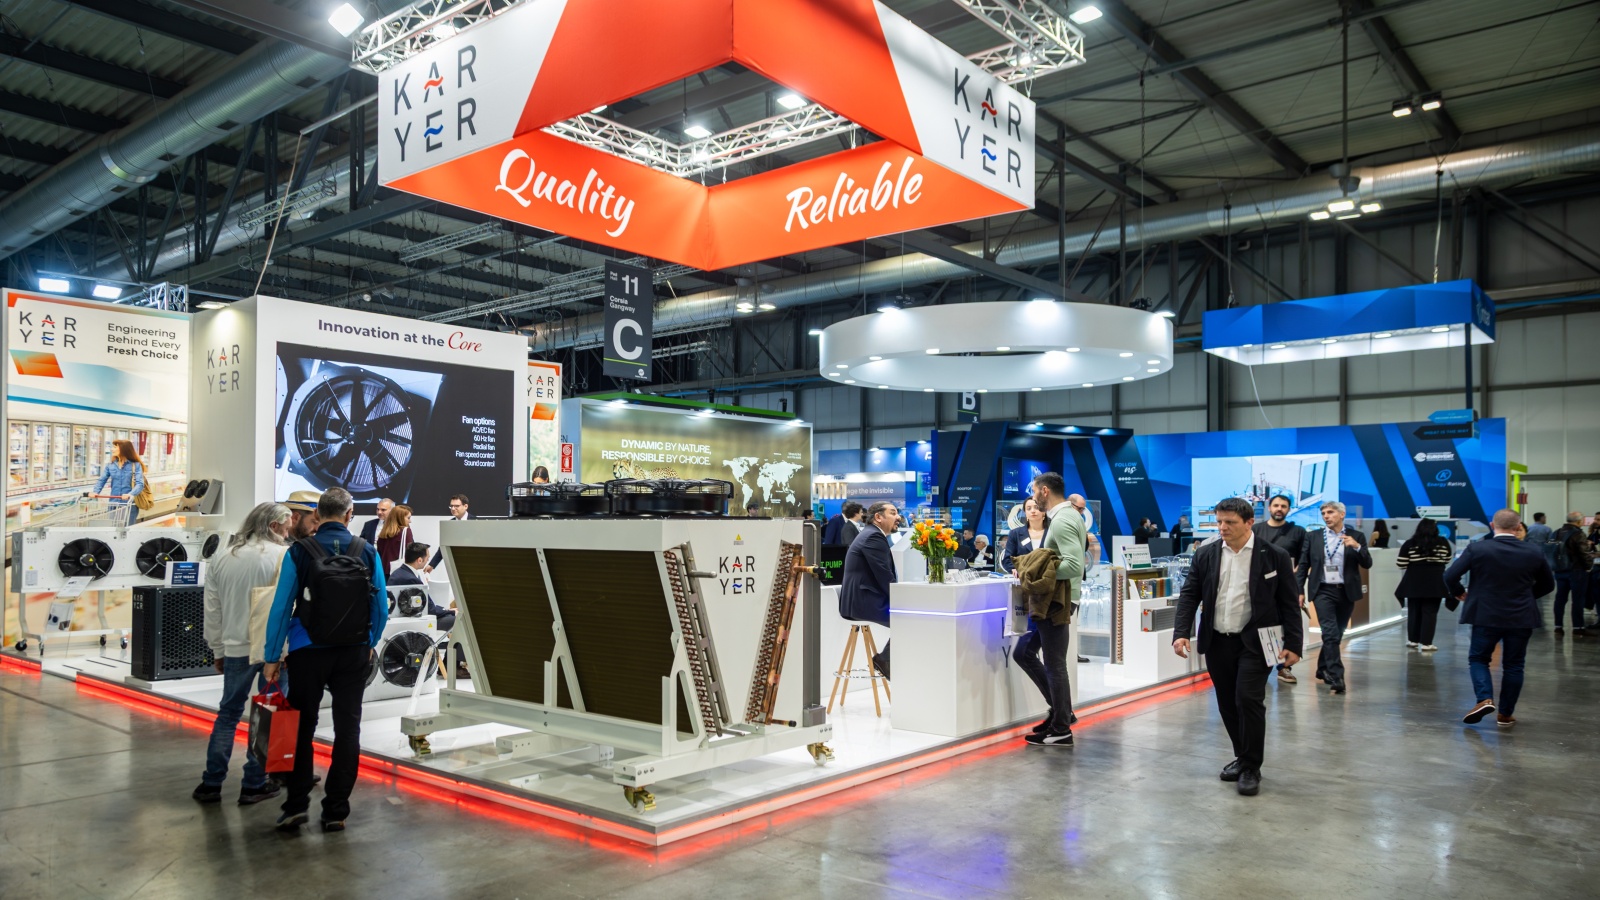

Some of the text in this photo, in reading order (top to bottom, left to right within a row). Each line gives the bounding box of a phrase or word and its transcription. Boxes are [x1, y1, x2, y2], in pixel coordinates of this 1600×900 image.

[394, 44, 477, 116] KAR
[954, 67, 1022, 142] KAR
[394, 97, 477, 162] YER
[954, 118, 1022, 188] YER
[495, 148, 635, 238] Quality
[784, 156, 924, 232] Reliable
[622, 275, 638, 296] 11
[610, 295, 628, 305] Corsia
[610, 302, 635, 313] Gangway
[19, 311, 77, 332] KAR
[108, 323, 176, 339] Engineering
[19, 328, 77, 349] YER
[108, 334, 181, 351] Behind Every
[318, 319, 483, 353] Innovation at the Core
[612, 318, 643, 360] C
[107, 346, 179, 360] Fresh Choice
[207, 344, 240, 369] KAR
[207, 370, 240, 394] YER
[462, 415, 496, 426] Fan options
[601, 450, 711, 465] RESPONSIBLE BY CHOICE.
[621, 439, 712, 455] DYNAMIC BY NATURE,
[869, 486, 894, 494] invisible
[719, 555, 756, 573] KAR
[825, 560, 842, 568] PUMP
[719, 577, 756, 595] YER
